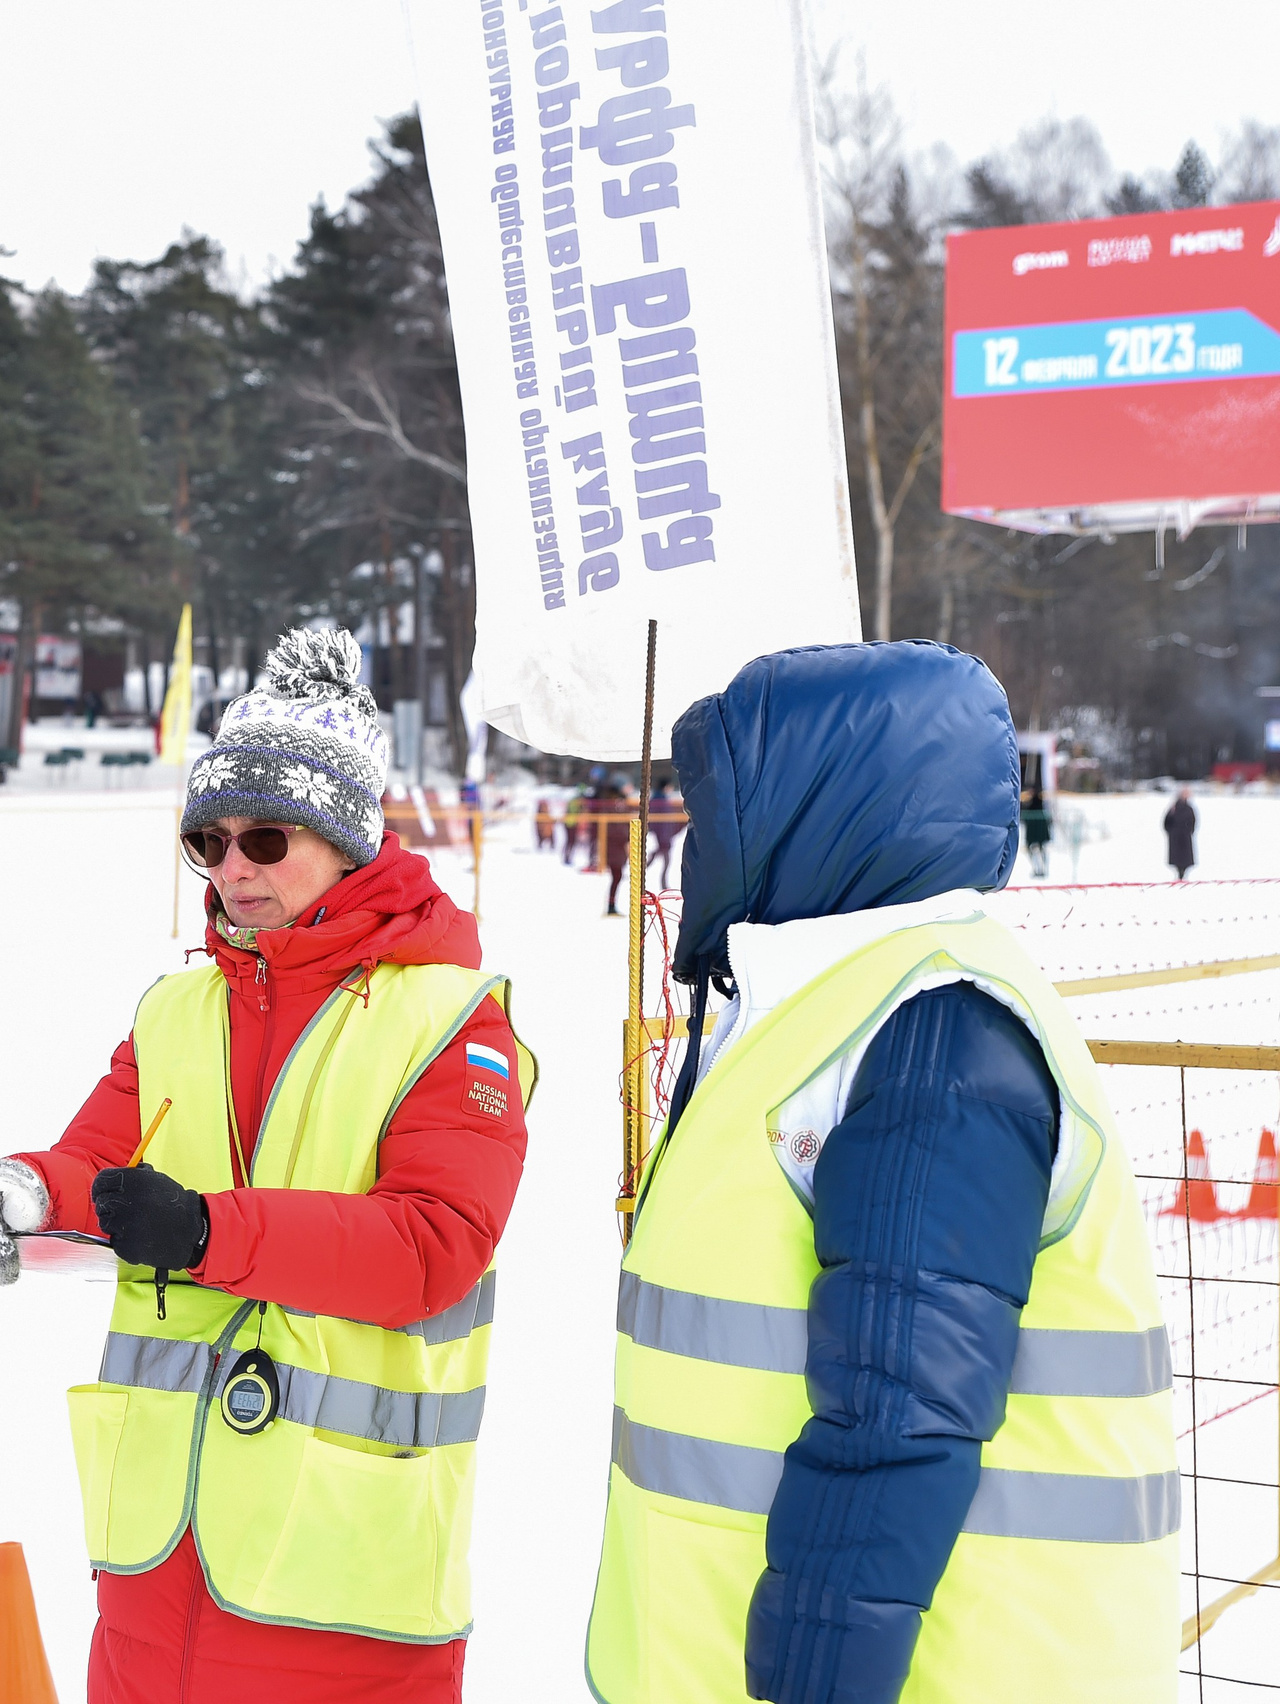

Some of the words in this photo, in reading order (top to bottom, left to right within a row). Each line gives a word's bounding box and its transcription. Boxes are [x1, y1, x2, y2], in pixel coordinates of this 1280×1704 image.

[983, 337, 1019, 386] 12
[1105, 323, 1195, 378] 2023
[468, 1090, 509, 1112] NATIONAL
[473, 1081, 507, 1102] RUSSIAN
[478, 1101, 502, 1117] TEAM
